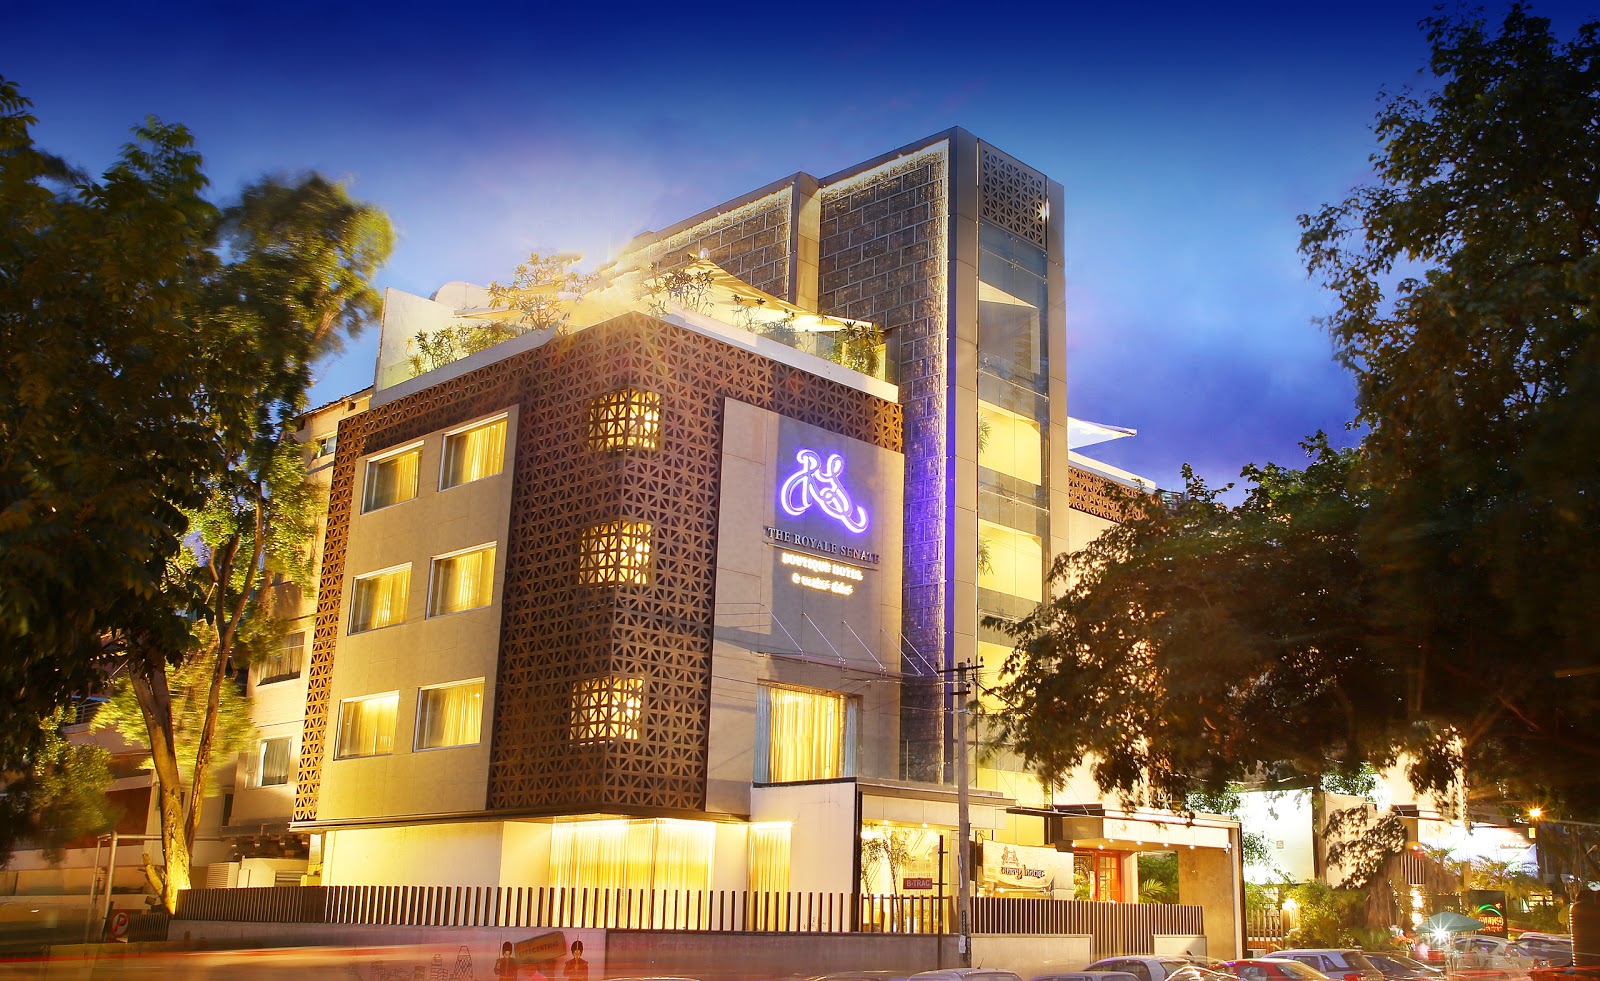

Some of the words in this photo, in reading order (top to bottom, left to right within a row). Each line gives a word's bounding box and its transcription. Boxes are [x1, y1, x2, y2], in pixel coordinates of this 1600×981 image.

[767, 527, 791, 542] THE
[794, 533, 838, 554] ROYALE
[840, 545, 880, 564] SENATE
